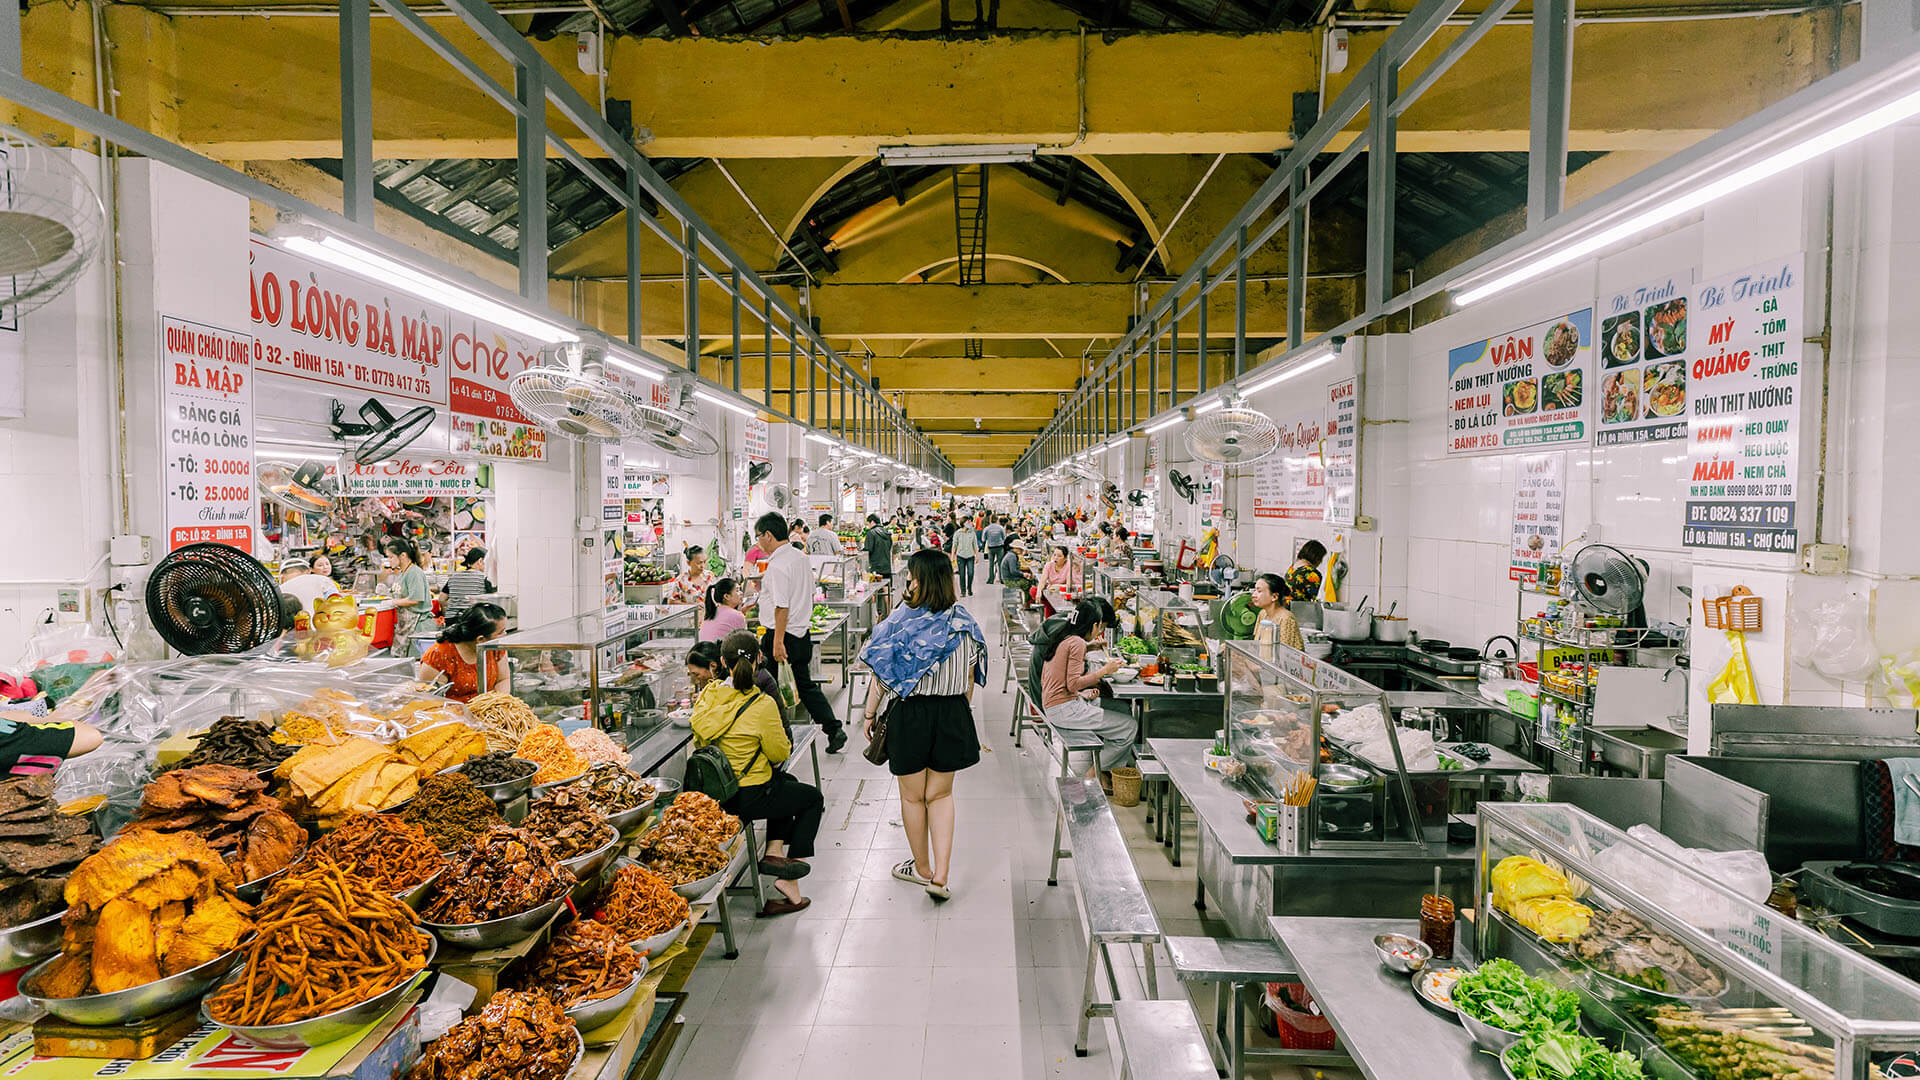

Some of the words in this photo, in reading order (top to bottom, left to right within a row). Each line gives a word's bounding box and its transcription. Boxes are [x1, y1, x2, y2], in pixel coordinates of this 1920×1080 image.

[1763, 296, 1778, 313] GÀ
[289, 272, 360, 347] LÒNG
[365, 297, 397, 357] BÀ
[401, 309, 443, 376] MẬP
[1762, 318, 1787, 336] TÔM
[167, 325, 196, 355] QUÁN
[197, 331, 223, 361] CHÁO
[225, 335, 249, 366] LÒNG
[1490, 336, 1534, 367] VÂN
[1761, 341, 1785, 359] THỊT
[266, 345, 282, 364] 32
[293, 349, 322, 373] ĐÌNH
[325, 358, 345, 377] 15A
[371, 369, 395, 387] 0779
[397, 374, 413, 393] 417
[415, 378, 431, 394] 375
[1692, 347, 1751, 380] QUẢNG
[1761, 362, 1798, 380] TRỨNG
[174, 359, 202, 388] BÀ
[205, 365, 244, 399] MẬP
[1455, 376, 1473, 392] BÚN
[1475, 372, 1495, 389] THỊT
[1496, 363, 1533, 383] NƯỚNG
[1454, 397, 1475, 411] NEM
[1476, 393, 1491, 410] LỤI
[1695, 394, 1717, 416] BÚN
[1720, 393, 1745, 415] THỊT
[1748, 384, 1793, 410] NƯỚNG
[178, 401, 217, 424] BẢNG
[219, 408, 241, 426] GIÁ
[1481, 408, 1499, 427] LỐT
[452, 415, 475, 432] Kem
[1636, 429, 1649, 441] 15A
[1655, 425, 1671, 440] CHỢ
[1745, 422, 1763, 436] HEO
[1765, 419, 1789, 434] QUAY
[171, 427, 211, 446] CHÁO
[214, 429, 249, 448] LÒNG
[527, 427, 546, 443] Sinh
[1454, 434, 1479, 450] BÁNH
[1744, 444, 1762, 457] HEO
[1765, 440, 1789, 458] LUỘC
[178, 454, 198, 473] TÔ:
[204, 459, 250, 476] 30.000đ
[1692, 451, 1735, 481] MẮM
[1744, 465, 1765, 479] NEM
[1767, 460, 1787, 479] CHẢ
[178, 481, 198, 501] TÔ:
[204, 486, 249, 501] 25.000đ
[405, 479, 423, 488] SINH
[1690, 485, 1699, 497] NH
[1709, 485, 1725, 497] BANK
[1726, 484, 1746, 496] 99999
[1747, 484, 1763, 496] 0824
[1764, 484, 1777, 496] 337
[1779, 484, 1792, 496] 109
[1691, 506, 1708, 521] ĐT:
[1709, 506, 1737, 522] 0824
[1739, 506, 1762, 523] 337
[1766, 506, 1789, 523] 109
[190, 528, 200, 541] LÔ
[201, 530, 211, 540] 32
[216, 528, 234, 540] ĐÌNH
[235, 528, 248, 540] 15A
[1684, 528, 1695, 543] LÔ
[1695, 531, 1706, 544] 04
[1707, 528, 1728, 546] ĐÌNH
[1729, 532, 1746, 547] 15A
[1753, 533, 1773, 551] CHỢ
